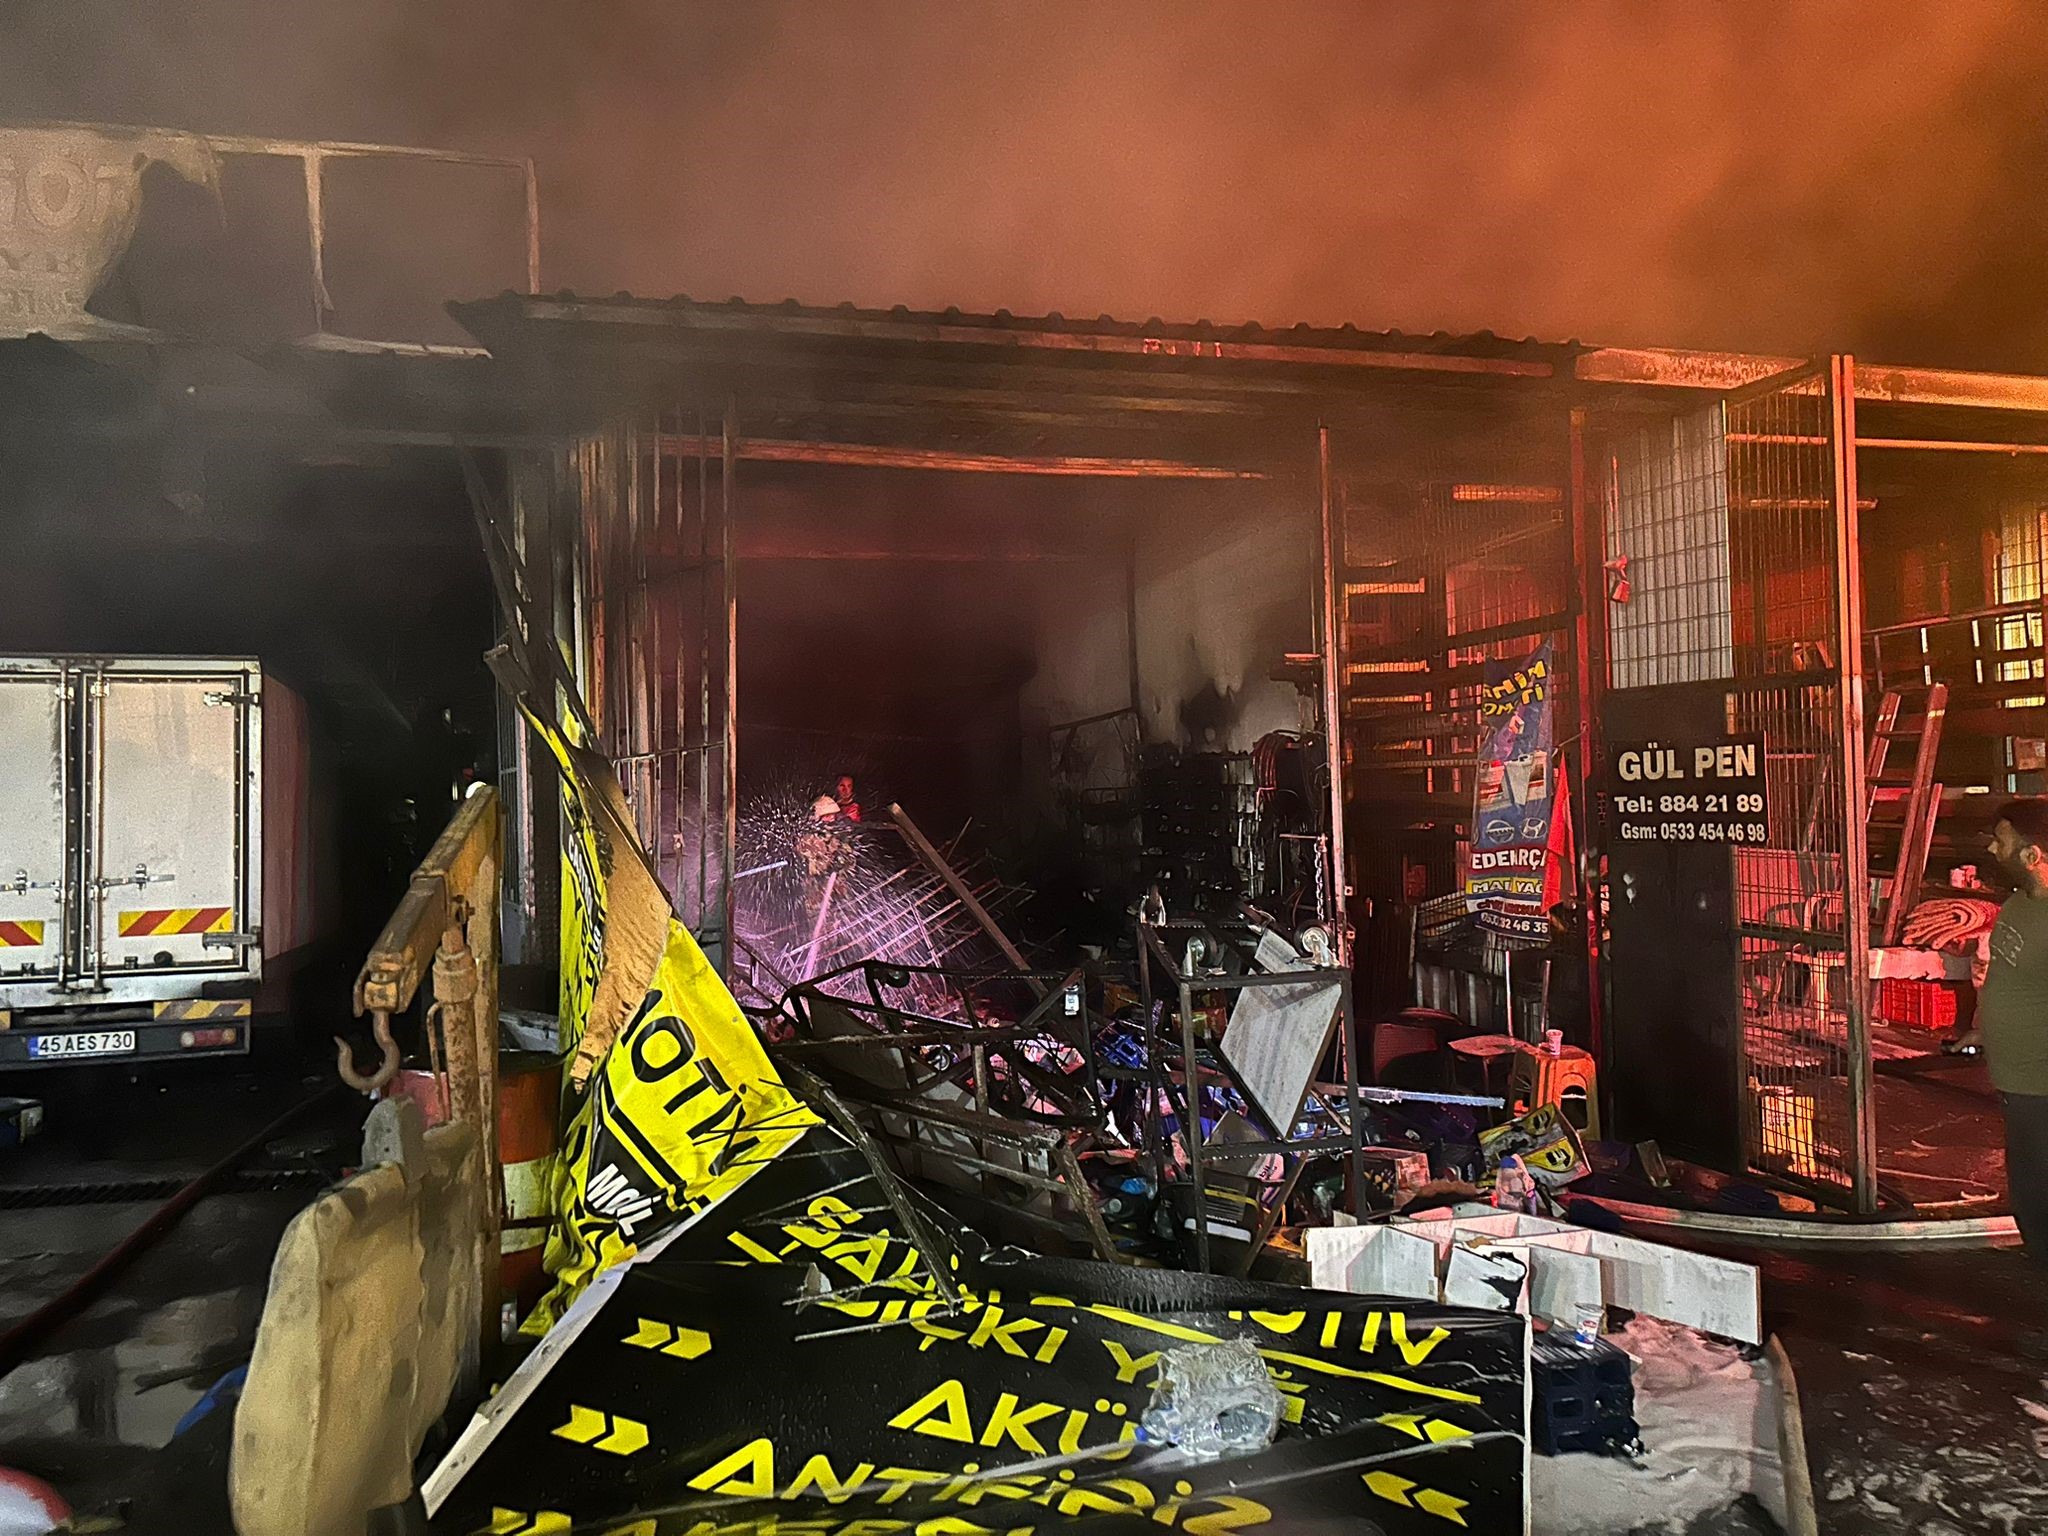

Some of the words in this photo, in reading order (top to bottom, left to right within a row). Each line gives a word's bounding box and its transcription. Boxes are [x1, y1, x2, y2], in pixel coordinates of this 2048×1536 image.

[1618, 742, 1684, 781] GÜL
[1695, 744, 1756, 778] PEN
[1614, 796, 1653, 813] Tel:
[1660, 795, 1699, 812] 884
[1705, 794, 1728, 812] 21
[1736, 794, 1764, 812] 89
[1621, 822, 1657, 839] Gsm:
[1660, 823, 1695, 840] 0533
[1699, 823, 1724, 841] 454
[1727, 823, 1744, 841] 46
[1747, 823, 1766, 842] 98
[39, 1037, 61, 1053] 45
[65, 1035, 97, 1052] AES
[101, 1033, 132, 1049] 730
[887, 1380, 1138, 1461] AKÜ
